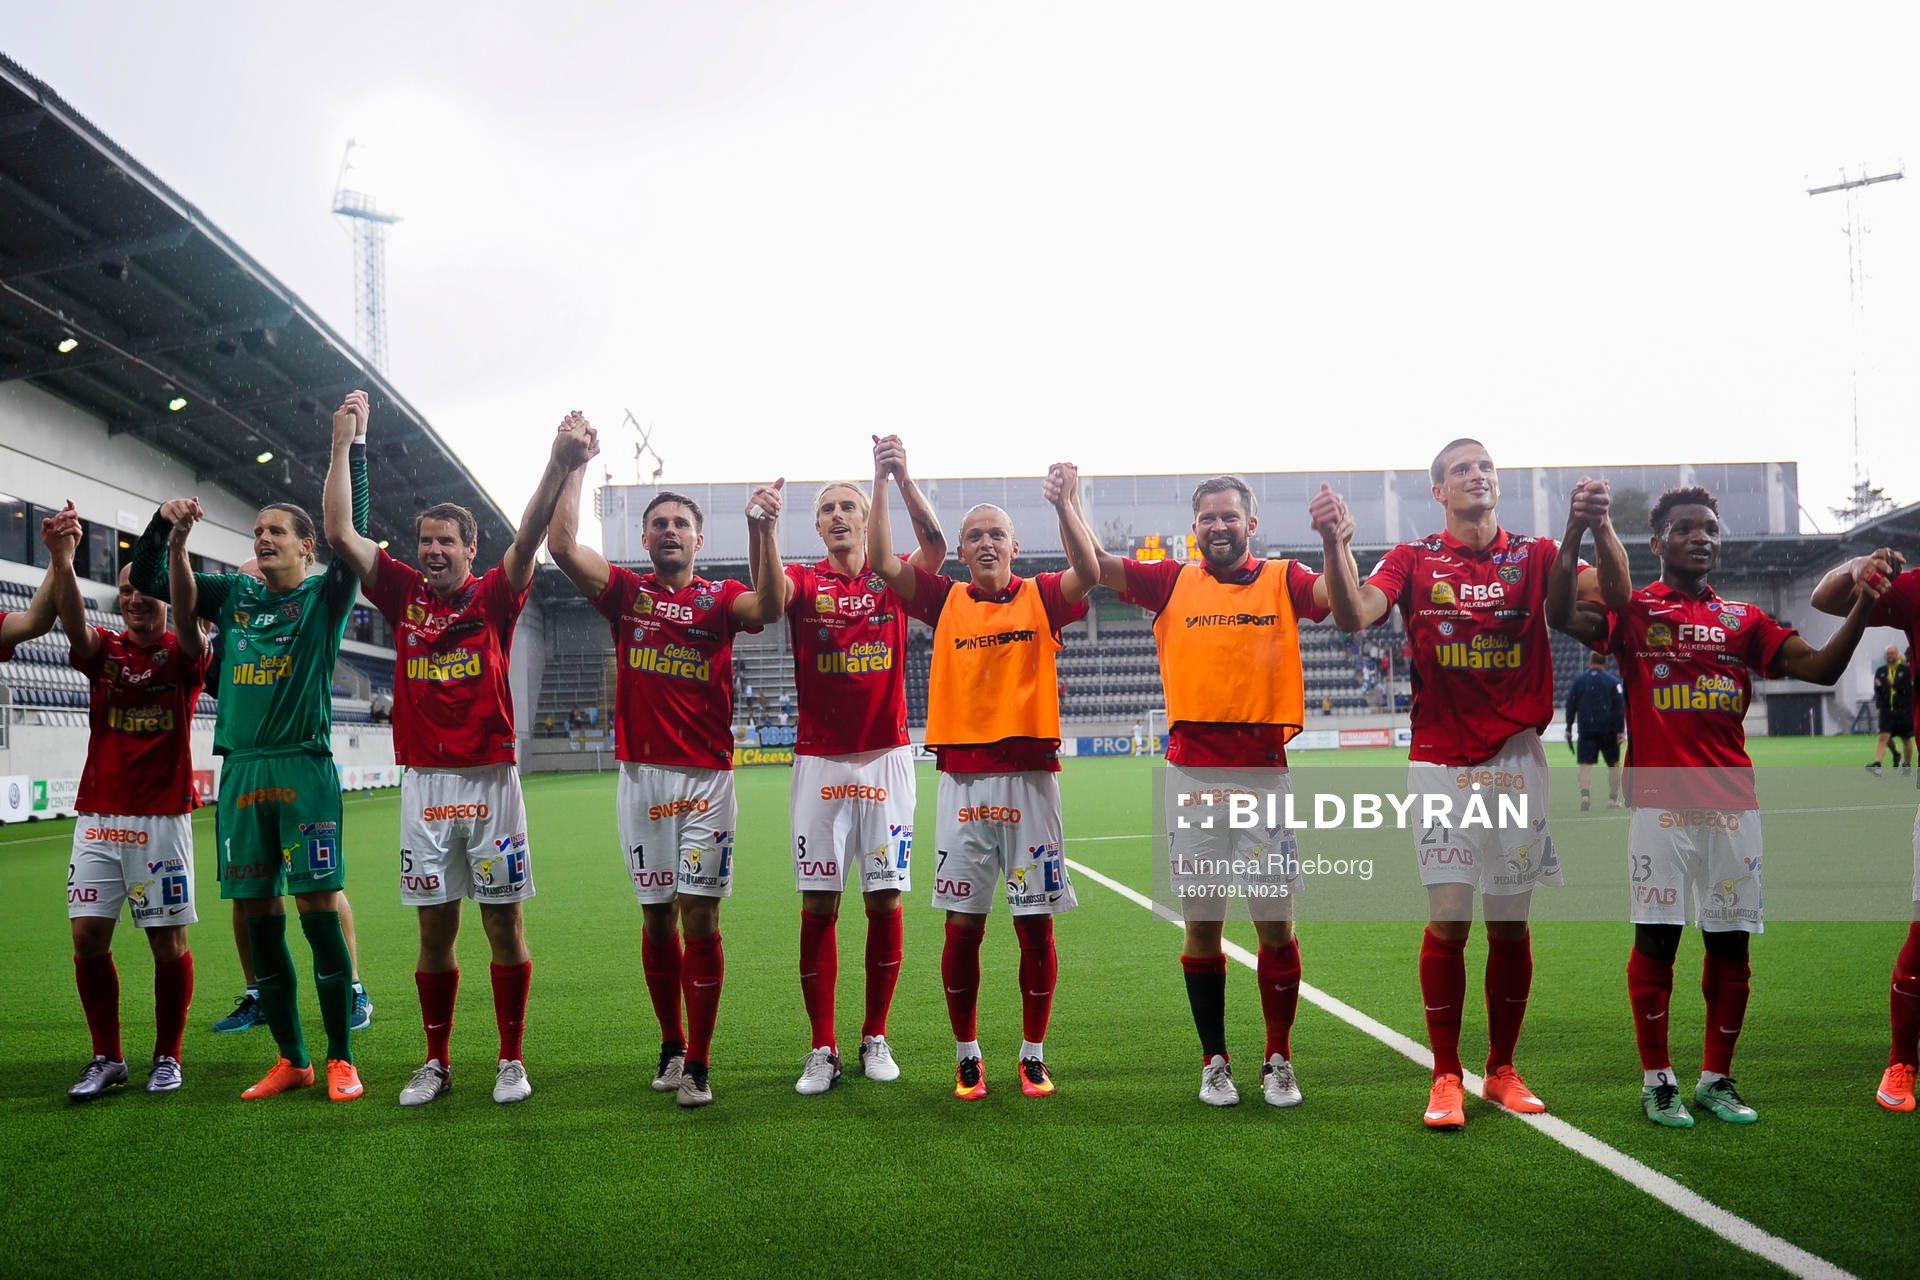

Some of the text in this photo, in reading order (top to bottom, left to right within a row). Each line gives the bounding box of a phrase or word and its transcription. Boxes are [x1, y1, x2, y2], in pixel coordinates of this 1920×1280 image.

[1460, 582, 1504, 600] FBG
[838, 594, 875, 610] FBG
[1460, 600, 1505, 608] FALKENBERG
[254, 613, 277, 626] FB
[1199, 613, 1276, 627] INTERSPORT
[1678, 624, 1725, 642] FBG
[432, 648, 469, 664] Gekås
[664, 643, 701, 661] Gekås
[849, 641, 887, 657] Gekås
[1435, 643, 1521, 669] Ullared
[1679, 643, 1726, 652] FALKENBERG
[407, 653, 481, 680] Ullared
[629, 648, 709, 681] Ullared
[817, 647, 893, 673] Ullared
[233, 655, 292, 685] Ullard
[1696, 674, 1736, 692] Gekås
[1653, 684, 1744, 713] Ullared
[743, 749, 793, 764] Cheers
[821, 784, 888, 802] sweaco
[423, 803, 489, 822] sweaco
[649, 799, 709, 821] sweaco
[958, 805, 1022, 823] sweaco
[1658, 809, 1740, 831] sweaco
[85, 828, 149, 845] sweaco
[1420, 818, 1449, 845] 21
[797, 835, 806, 859] 8
[937, 850, 948, 873] 7
[1631, 854, 1652, 882] 23
